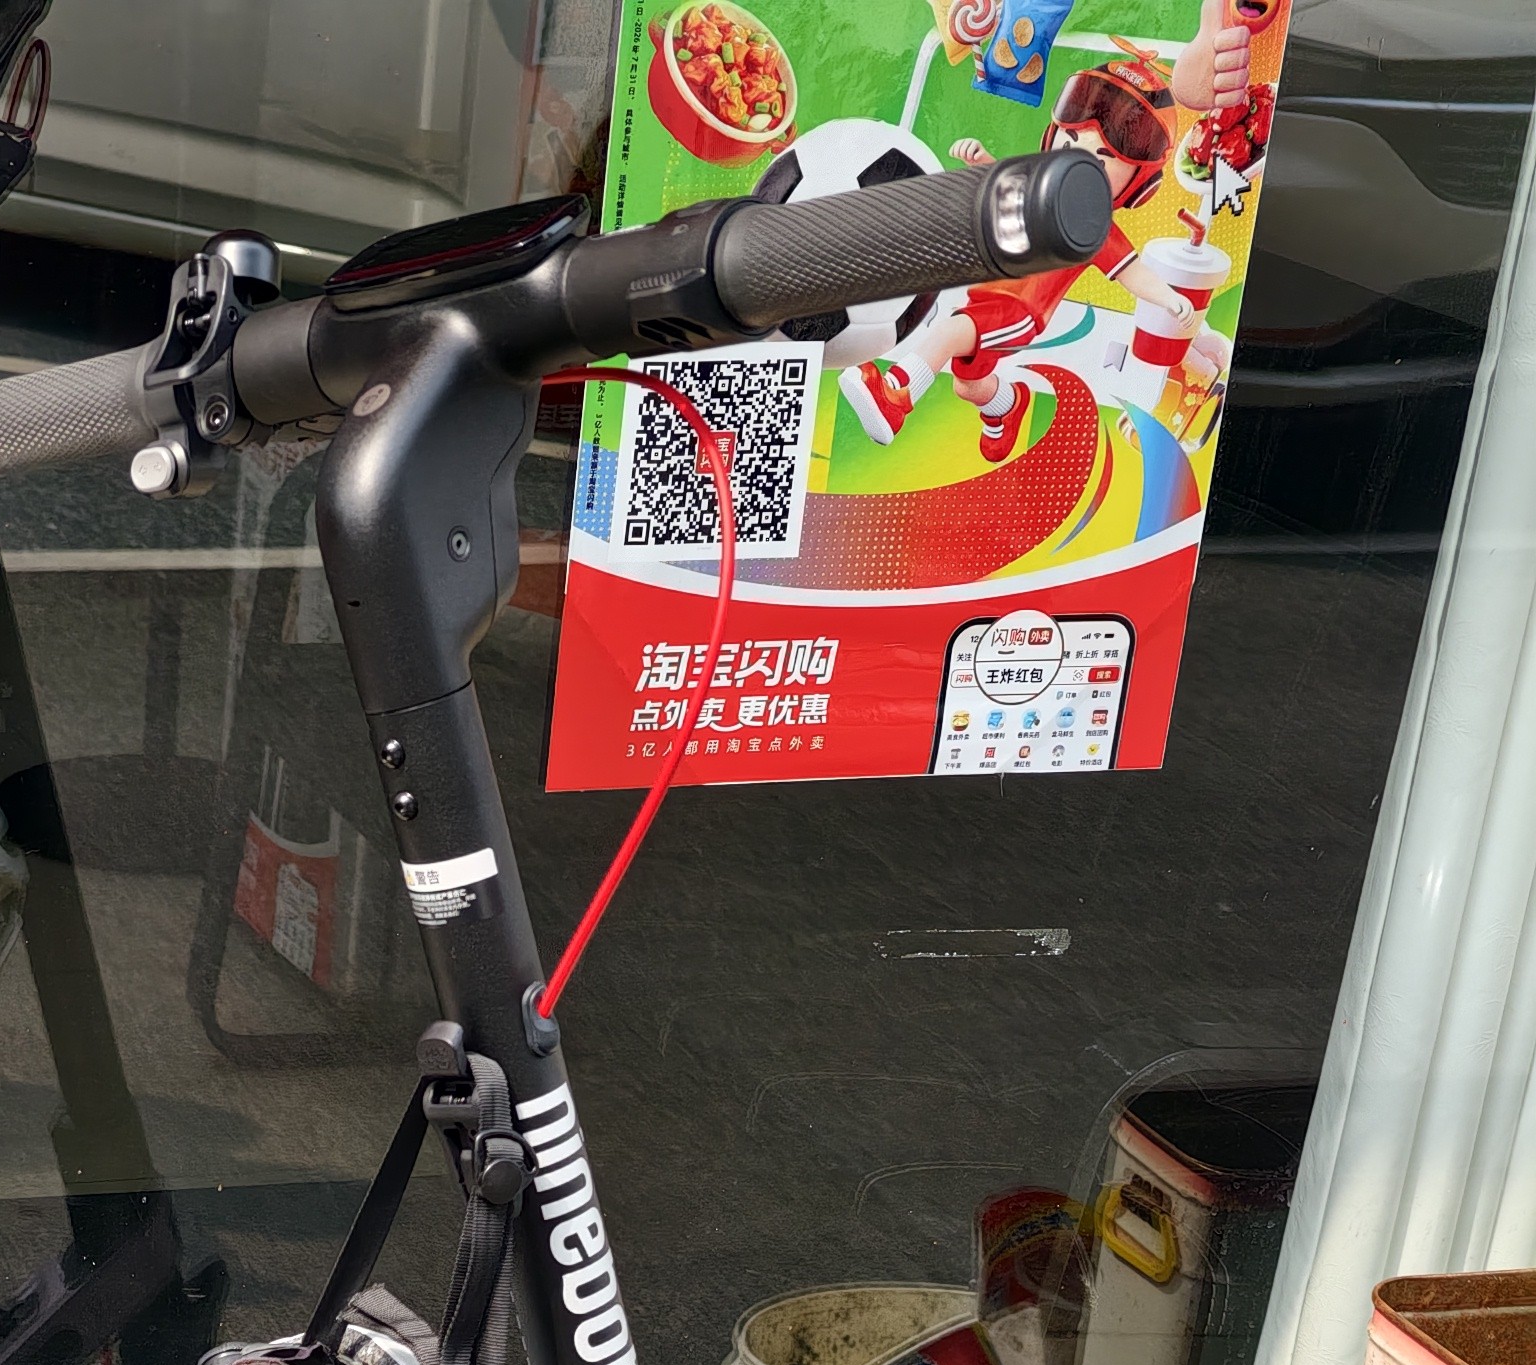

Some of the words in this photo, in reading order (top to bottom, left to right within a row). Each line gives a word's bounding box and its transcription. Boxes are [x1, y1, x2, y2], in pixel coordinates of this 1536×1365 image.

[991, 628, 1026, 647] 闪购
[1030, 630, 1050, 642] 外卖
[634, 636, 840, 692] 淘宝闪购
[985, 668, 1043, 684] 王炸红包
[738, 694, 831, 726] 更优惠
